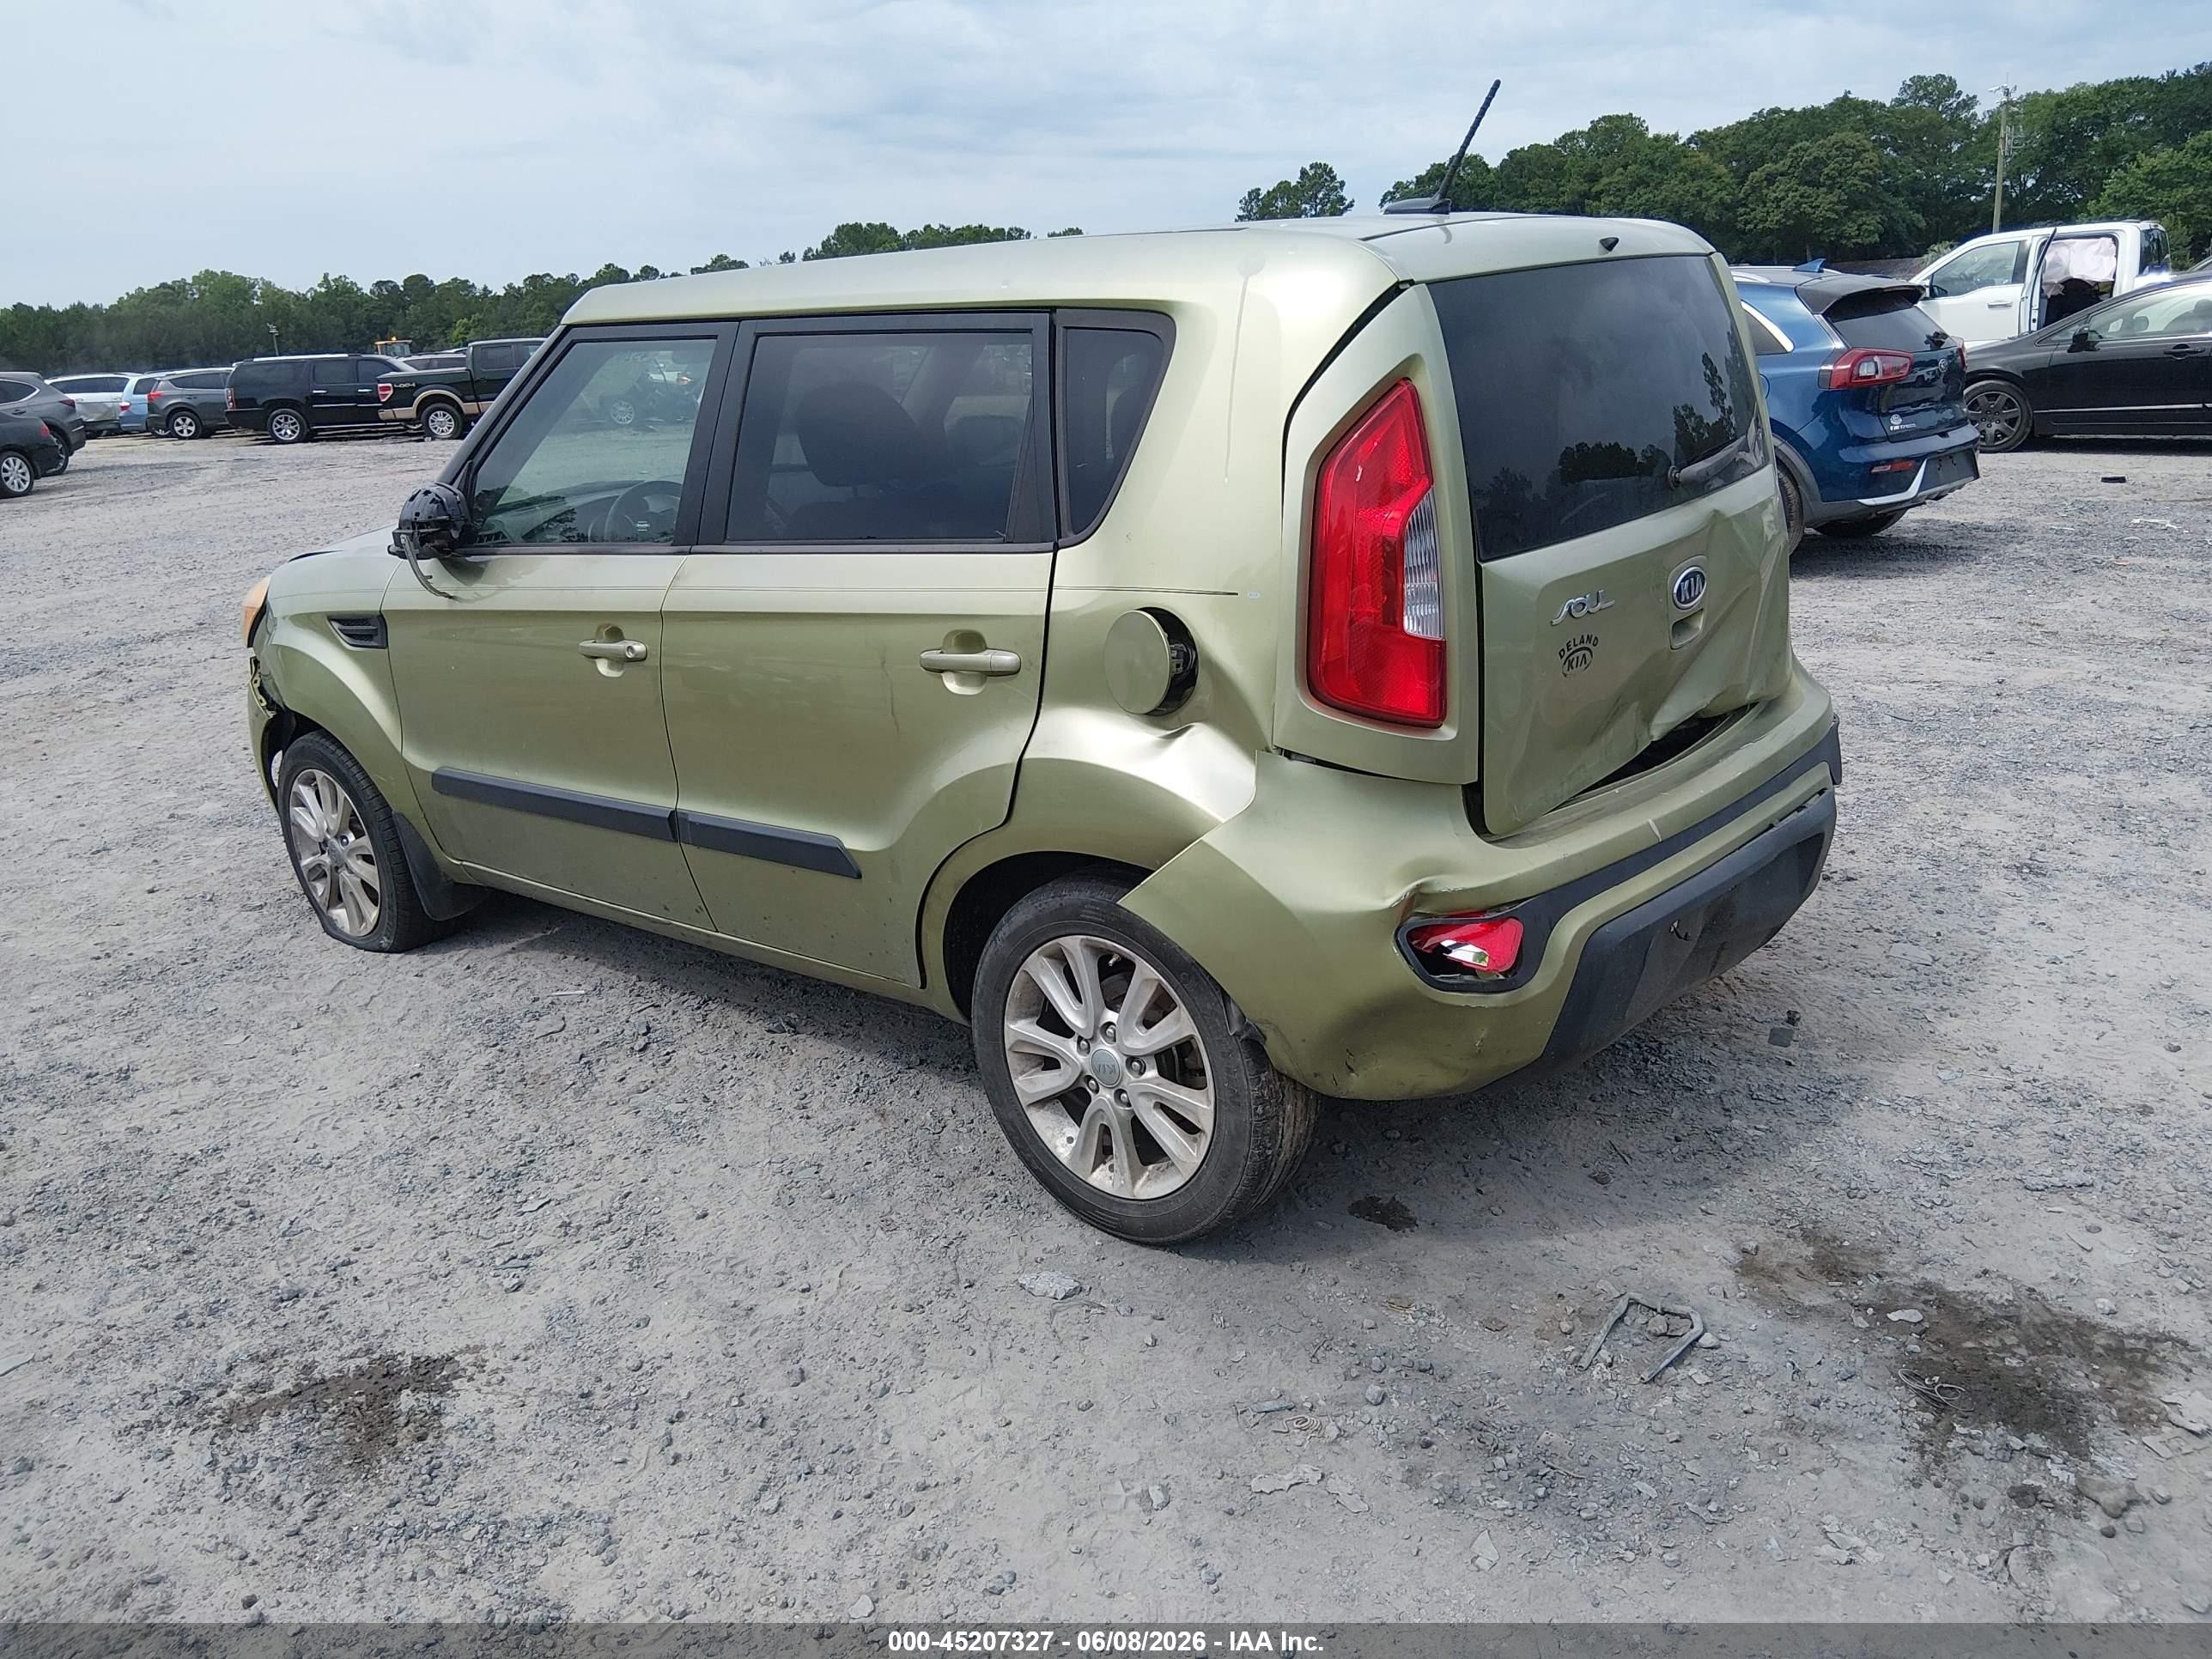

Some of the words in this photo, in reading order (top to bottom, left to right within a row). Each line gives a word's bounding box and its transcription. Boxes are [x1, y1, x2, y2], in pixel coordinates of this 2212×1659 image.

[1680, 574, 1703, 602] KIA
[1559, 634, 1599, 660] DELAND
[1567, 653, 1587, 672] KIA
[1092, 1063, 1116, 1074] KIA
